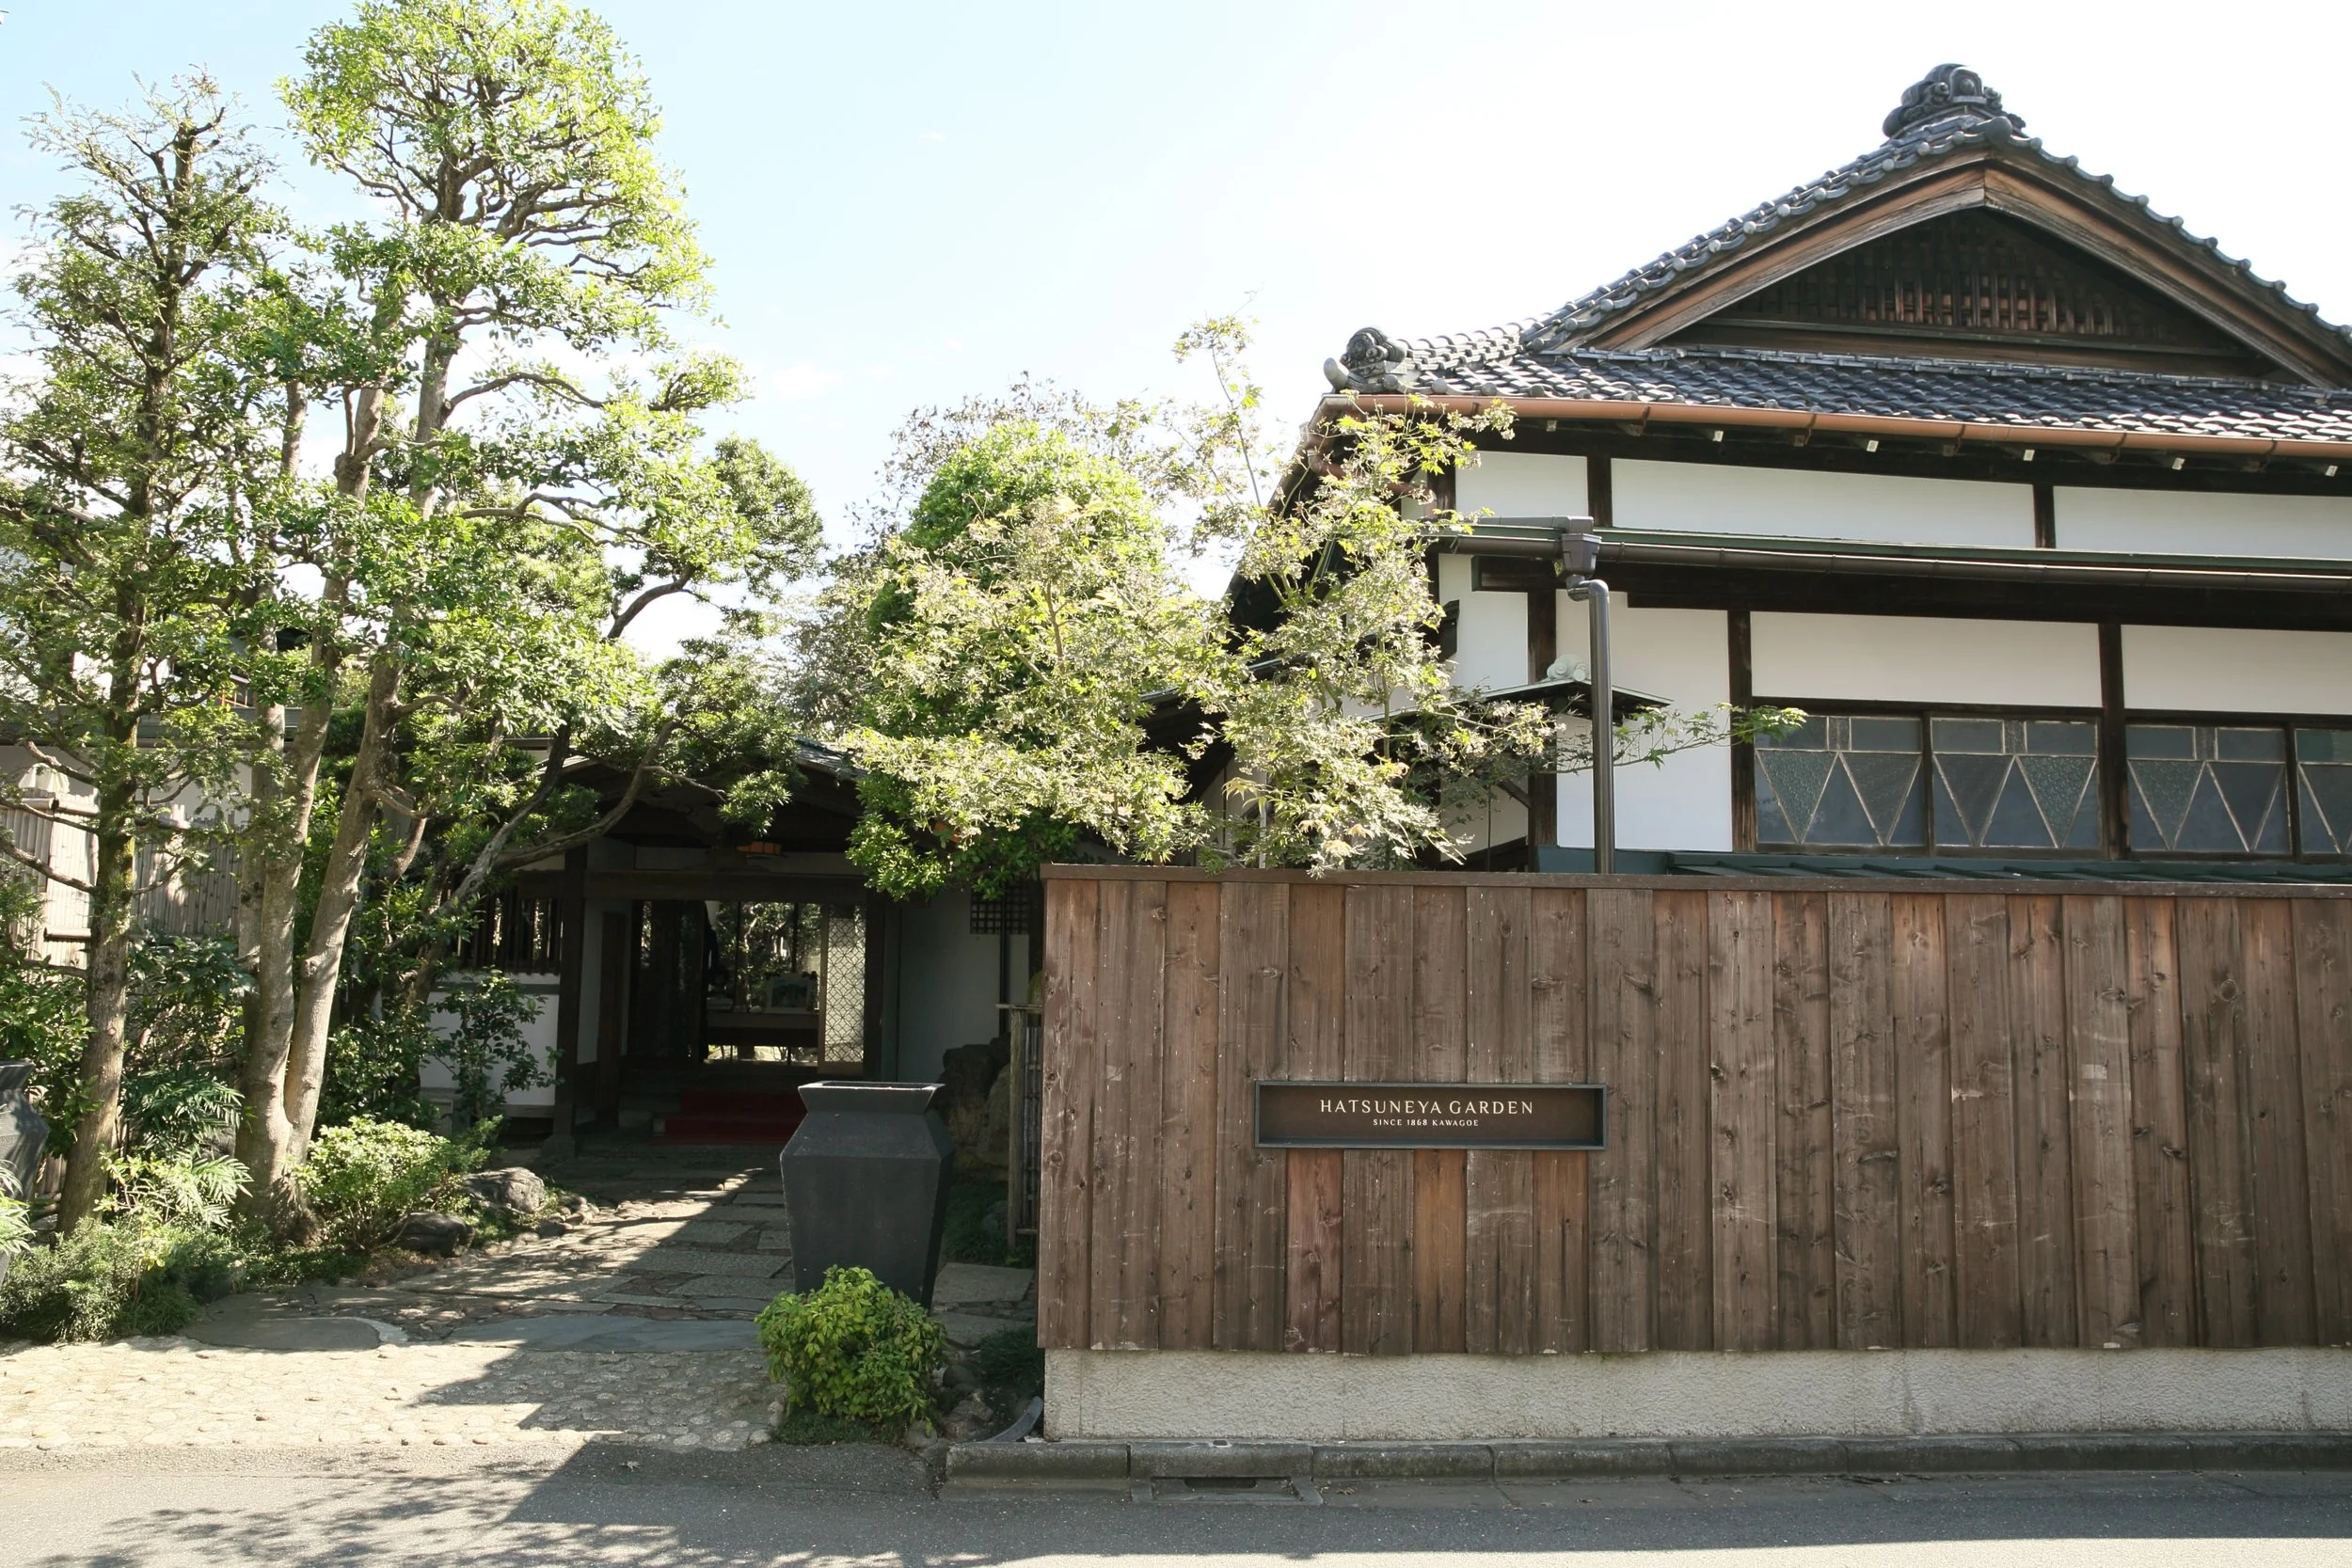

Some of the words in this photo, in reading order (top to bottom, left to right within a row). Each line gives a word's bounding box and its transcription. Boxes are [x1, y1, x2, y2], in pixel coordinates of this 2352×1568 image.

[1320, 1099, 1442, 1115] HATSUNEYA
[1449, 1100, 1534, 1115] GARDEN
[1373, 1118, 1403, 1127] SINCE
[1406, 1118, 1428, 1127] 1868
